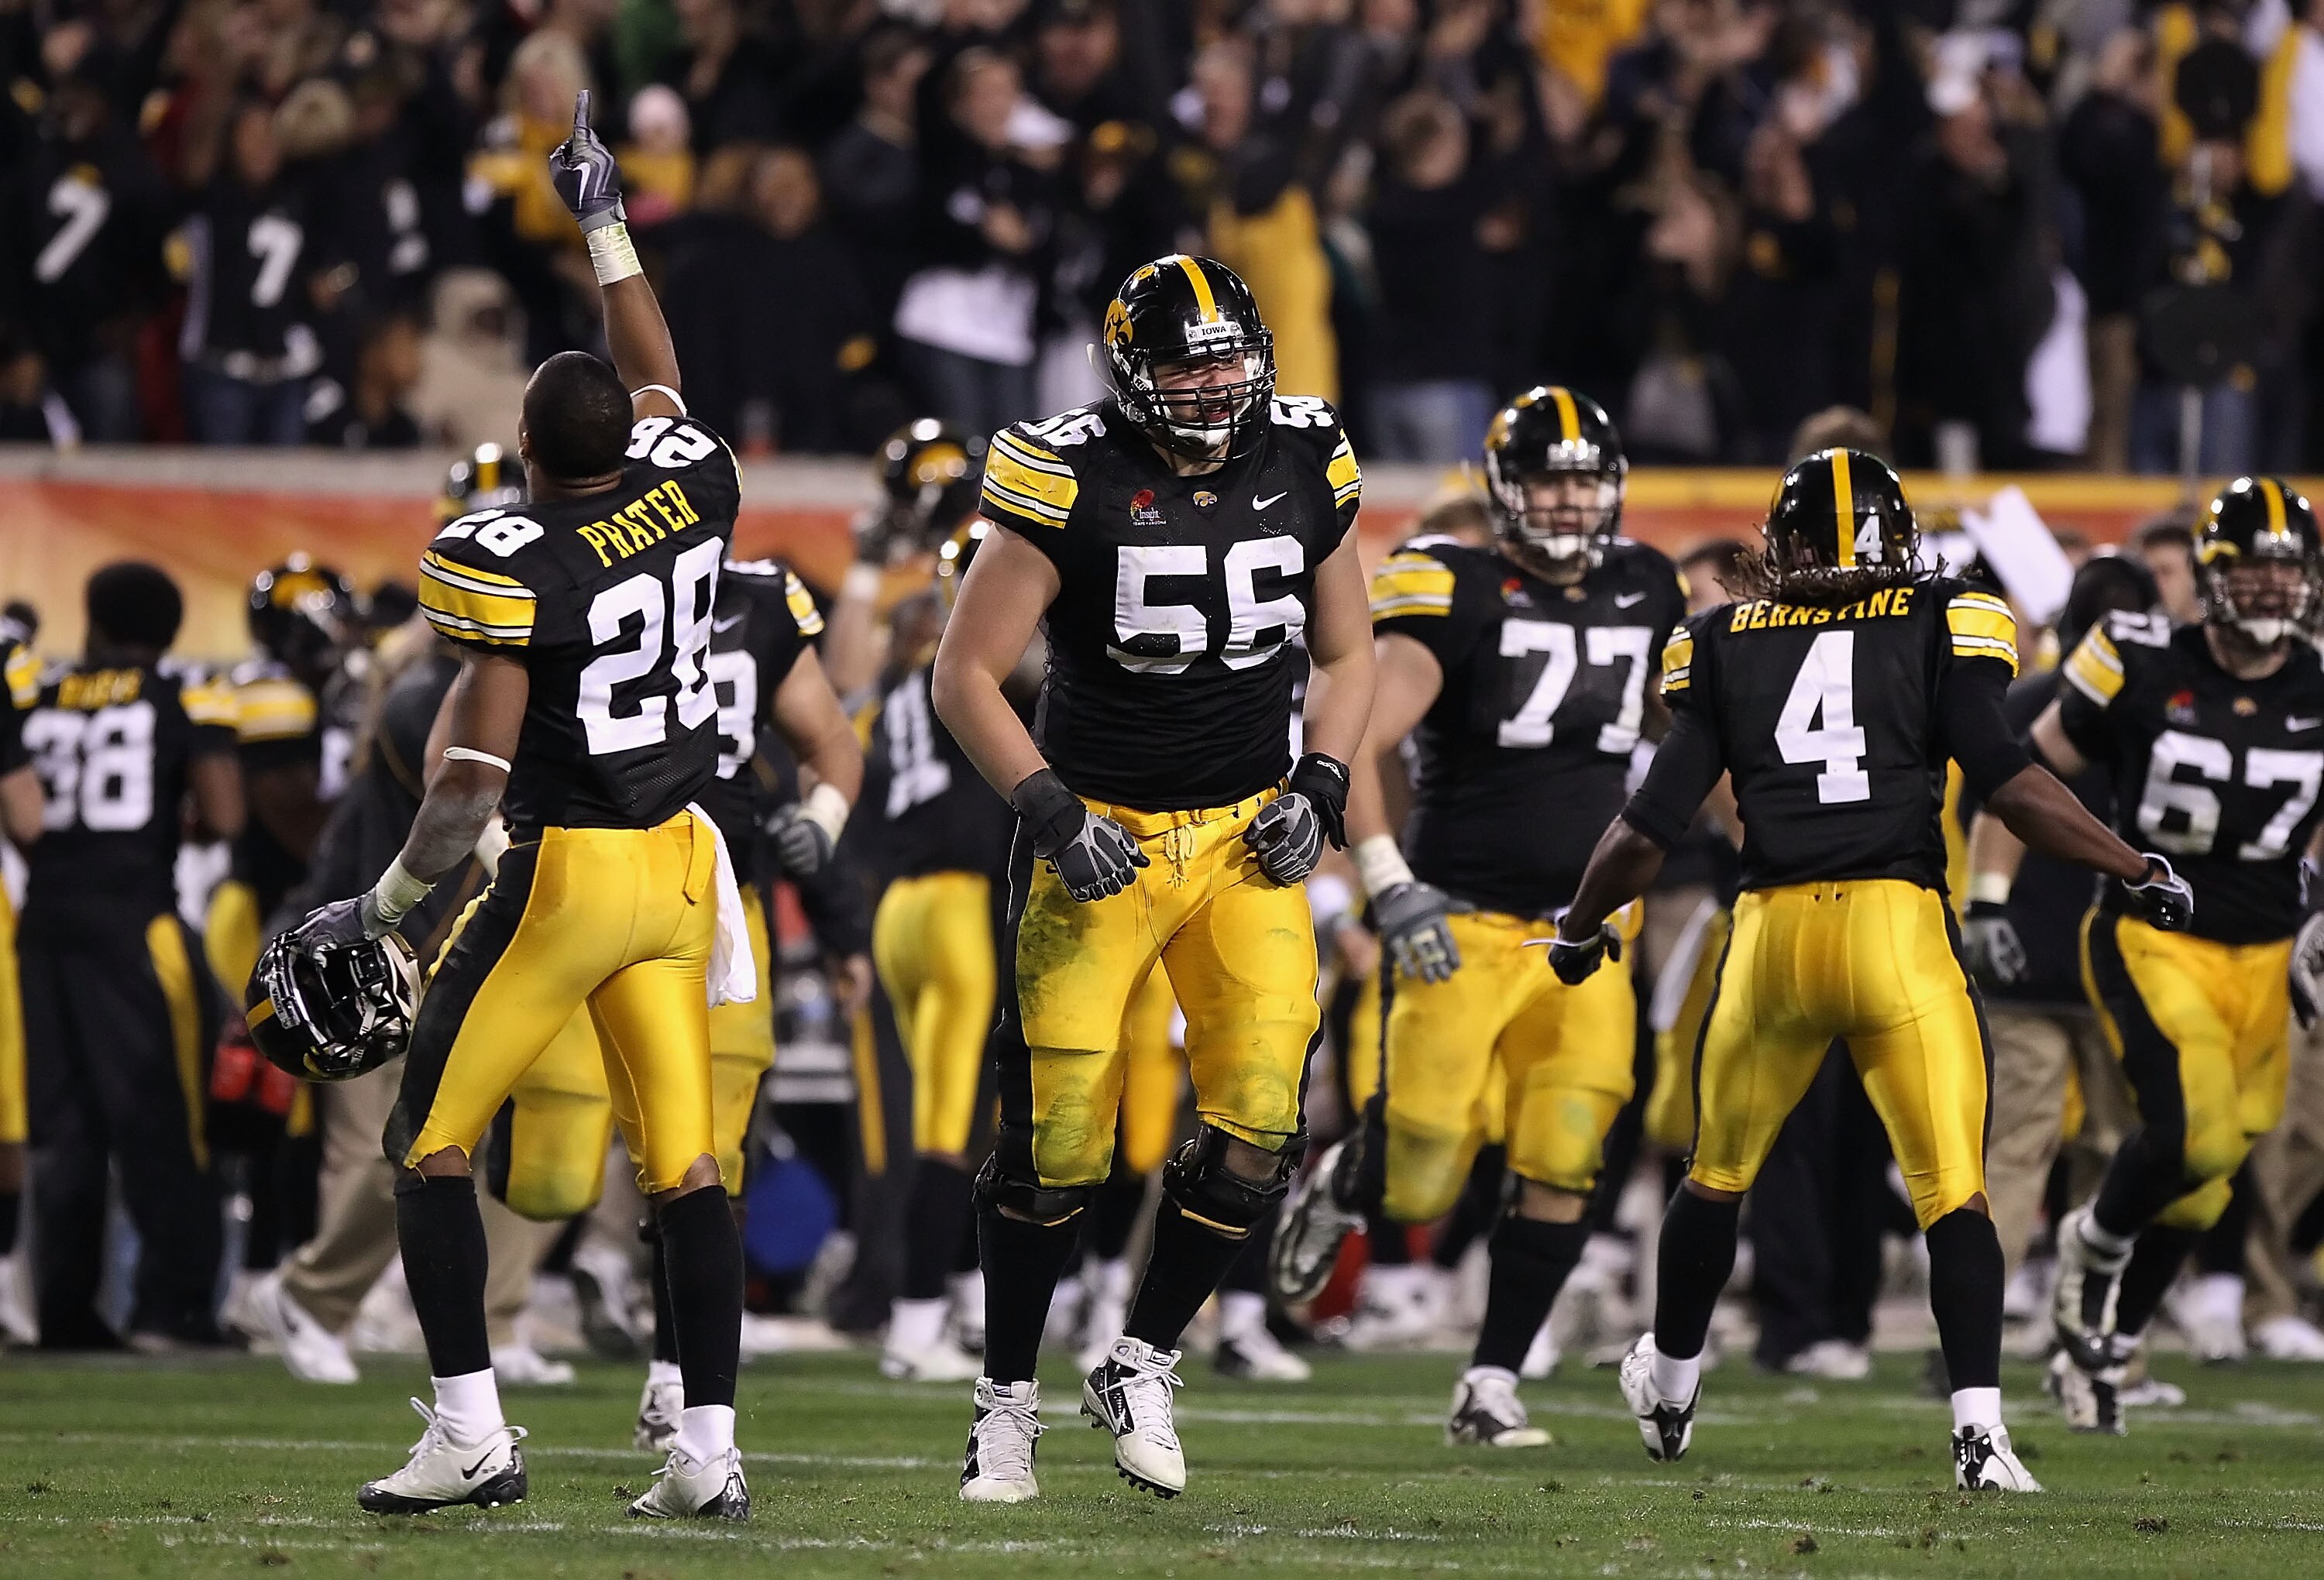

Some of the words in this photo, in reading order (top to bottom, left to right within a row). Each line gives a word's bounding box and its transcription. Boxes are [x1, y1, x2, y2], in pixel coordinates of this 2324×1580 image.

[1202, 325, 1227, 335] IOWA
[435, 508, 545, 558] 28
[576, 479, 700, 568] PRATER
[1854, 514, 1883, 564] 4
[576, 536, 724, 755] 28
[1106, 534, 1306, 675] 56
[1497, 617, 1654, 754] 77
[1774, 630, 1871, 805] 4
[21, 699, 156, 833] 38
[2137, 729, 2324, 862] 67
